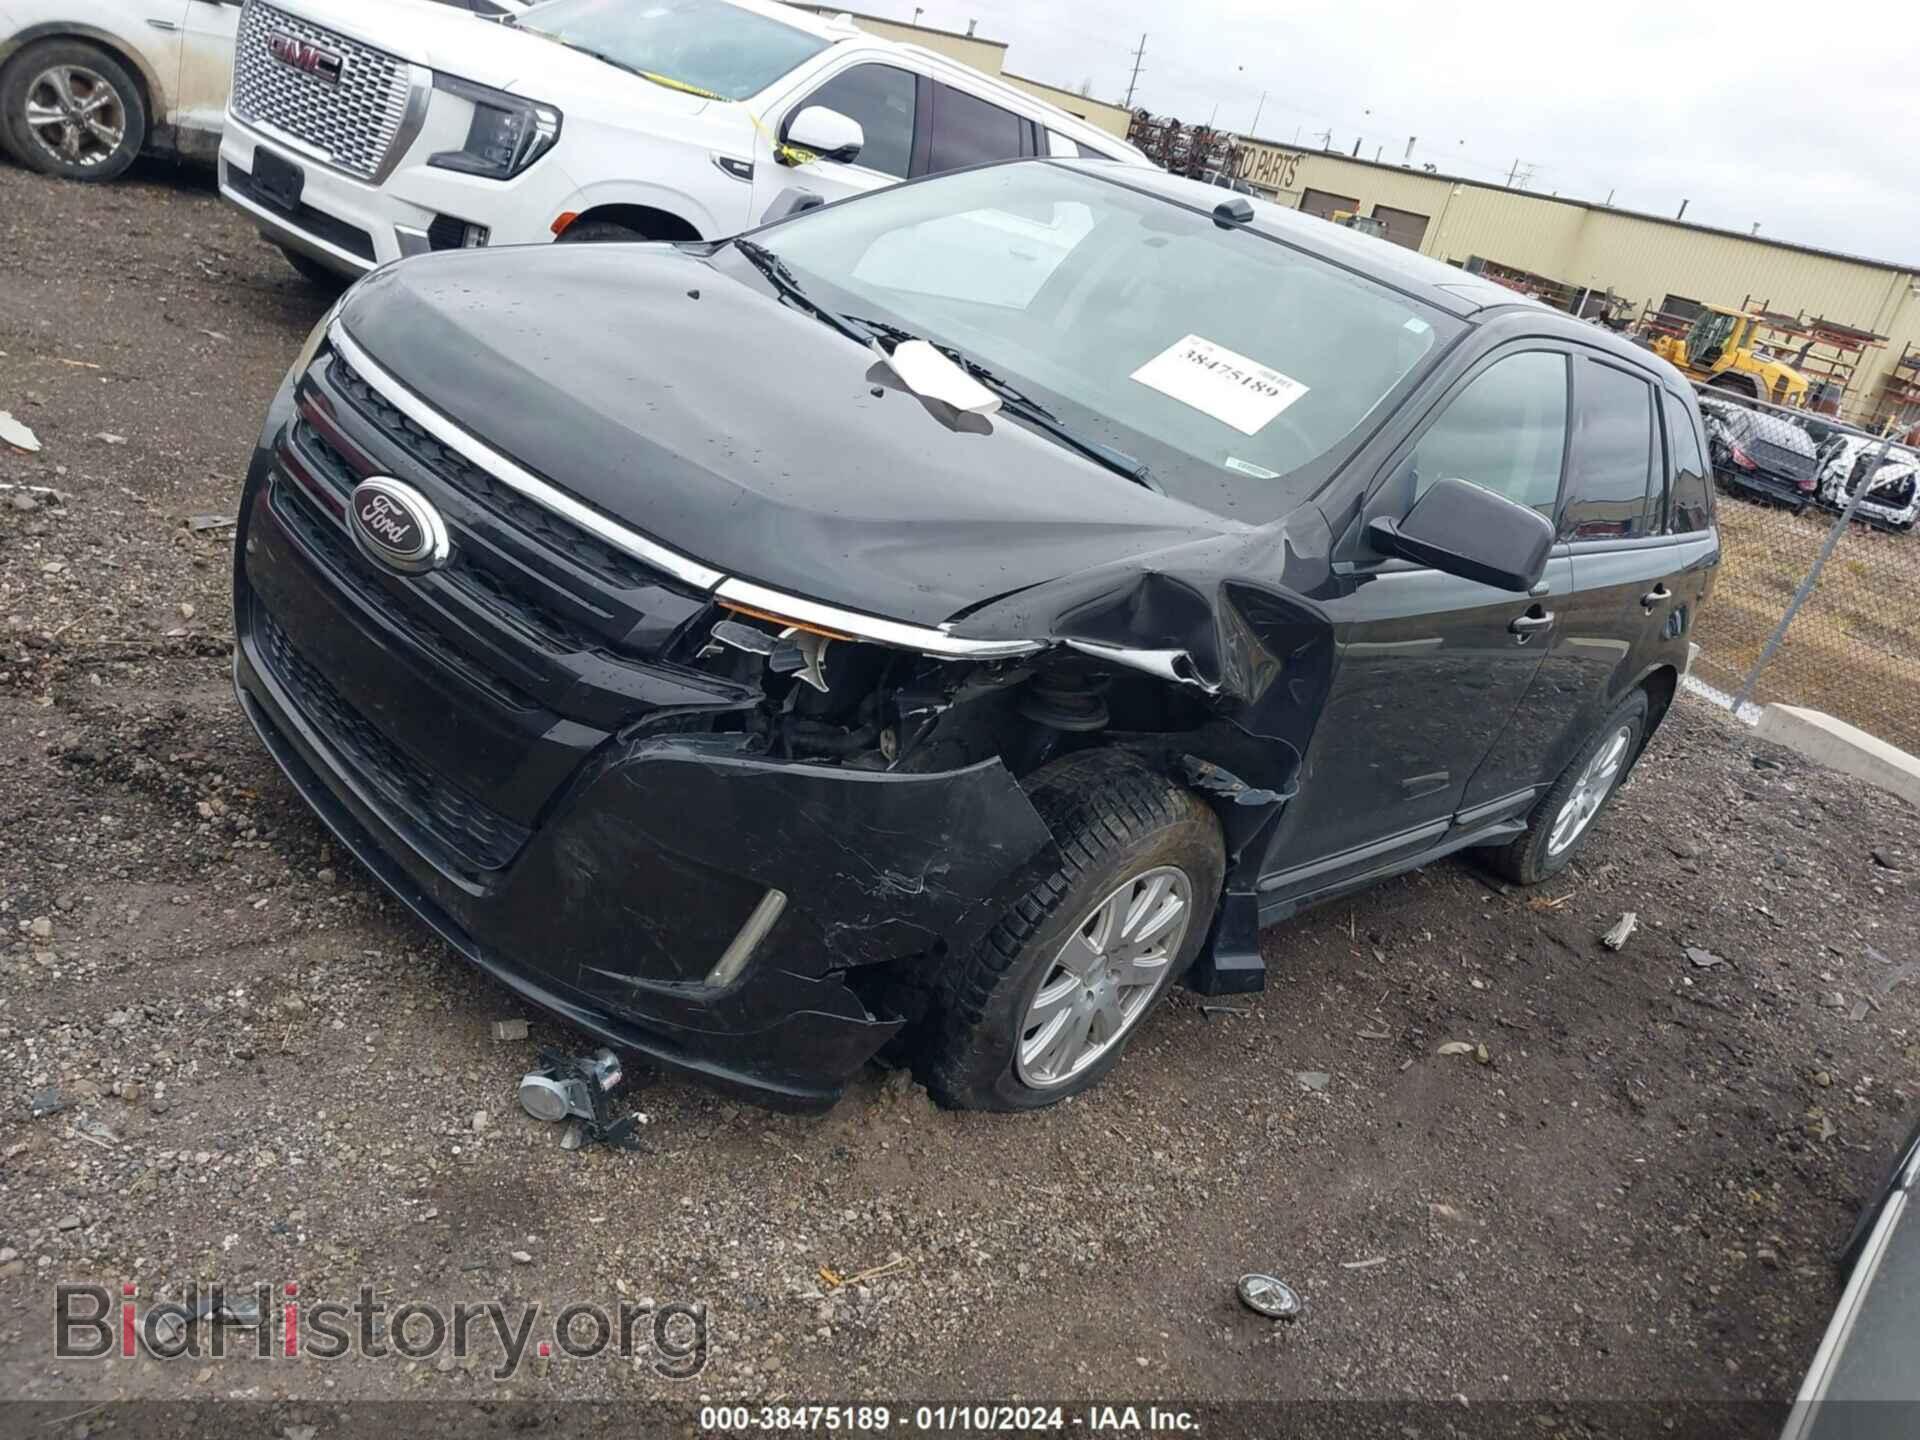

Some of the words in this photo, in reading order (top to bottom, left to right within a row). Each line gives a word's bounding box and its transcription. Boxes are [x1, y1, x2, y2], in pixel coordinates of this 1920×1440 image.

[271, 32, 340, 83] GMC
[1254, 150, 1302, 187] PARTS
[1179, 349, 1279, 397] 38475189
[361, 495, 411, 544] Ford
